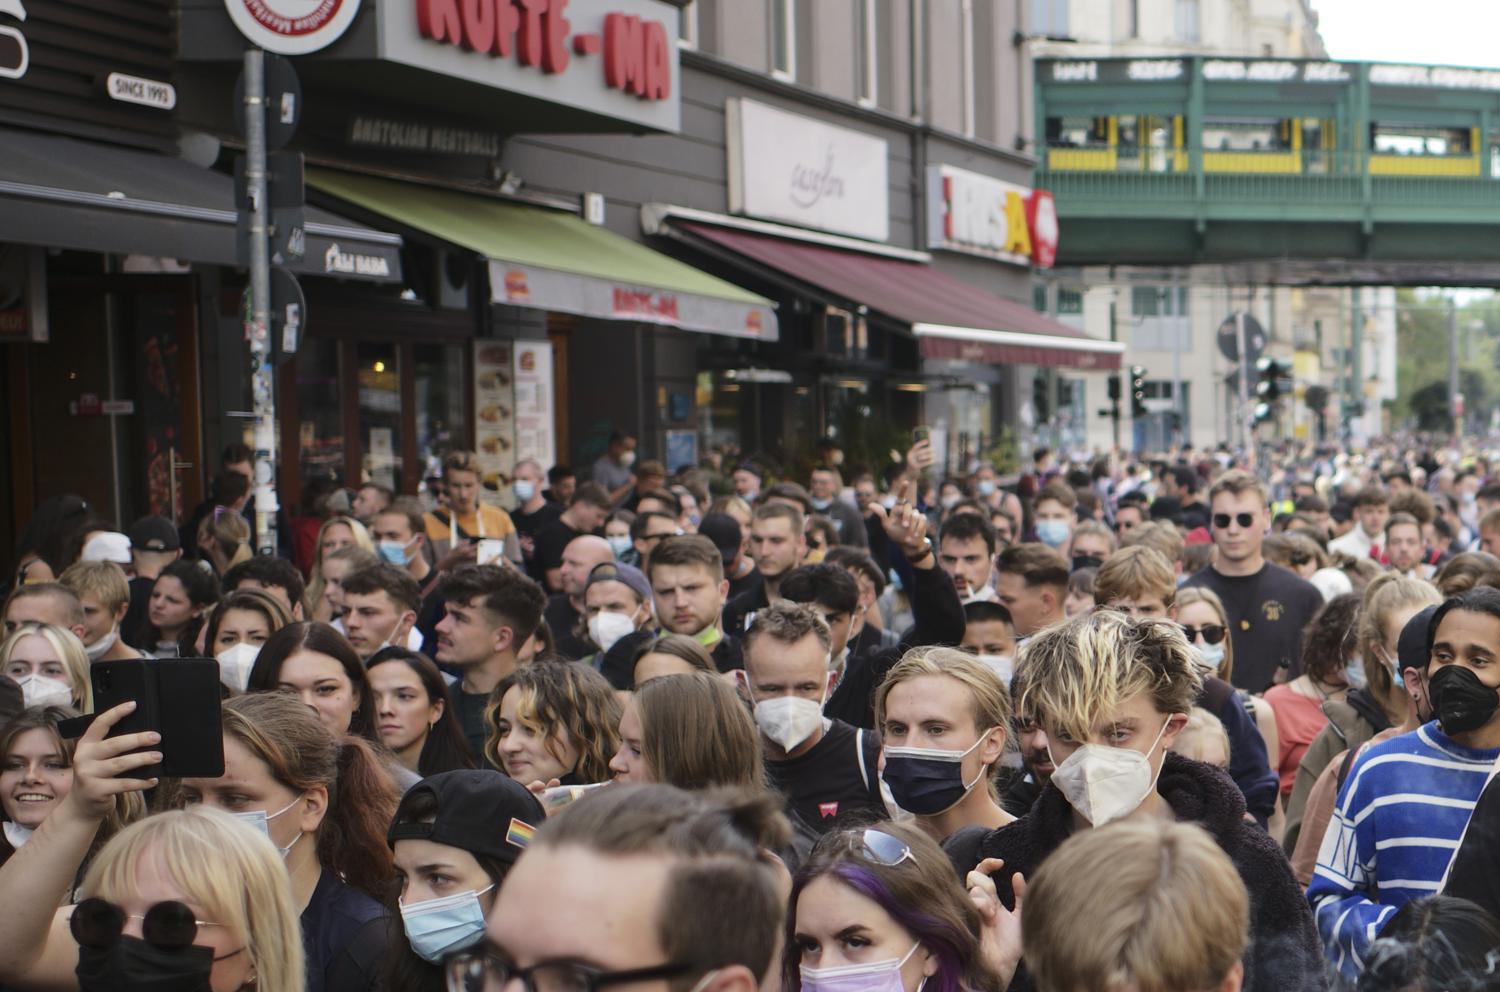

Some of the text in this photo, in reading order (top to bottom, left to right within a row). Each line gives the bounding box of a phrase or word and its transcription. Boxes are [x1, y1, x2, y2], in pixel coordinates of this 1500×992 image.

[115, 78, 144, 98] SINCE
[352, 117, 498, 157] ANATOLIAN MEATBALLS
